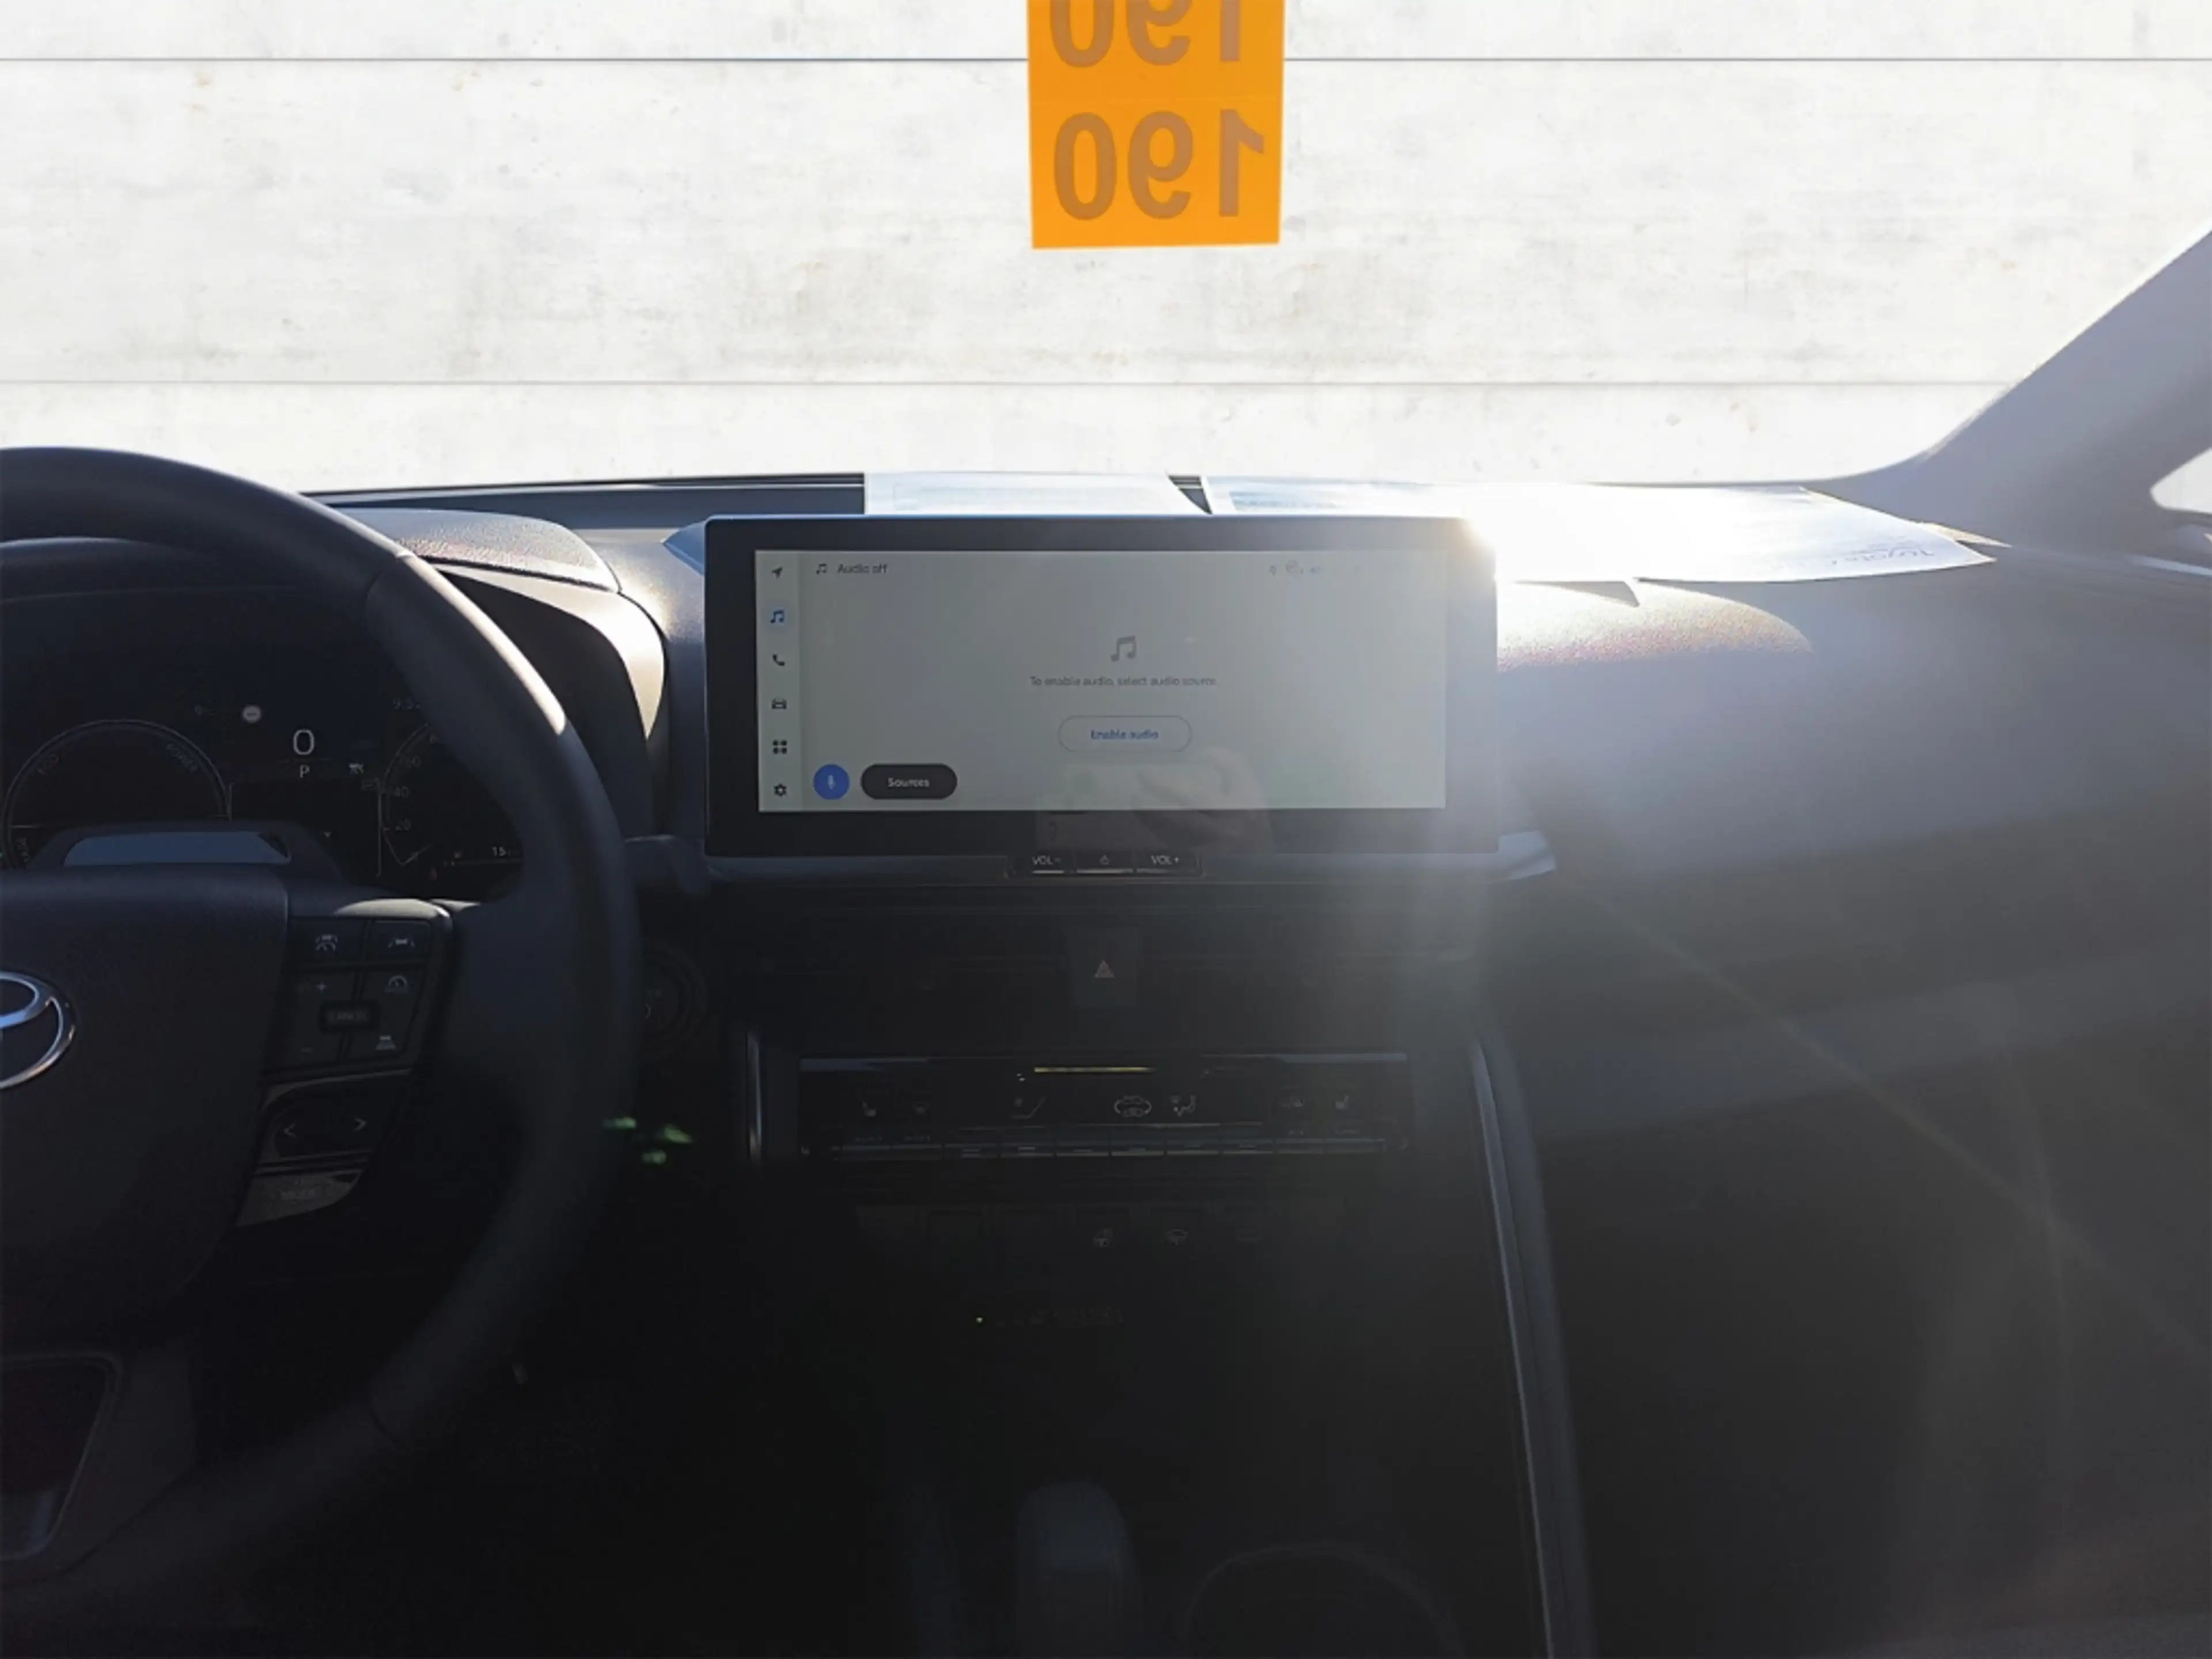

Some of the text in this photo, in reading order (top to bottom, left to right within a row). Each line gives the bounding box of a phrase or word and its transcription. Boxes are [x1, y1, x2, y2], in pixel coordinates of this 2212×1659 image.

[837, 562, 888, 574] Audio off
[1029, 676, 1042, 686] To
[1090, 729, 1159, 740] Enable audio
[300, 764, 310, 778] P
[887, 777, 930, 787] Sources
